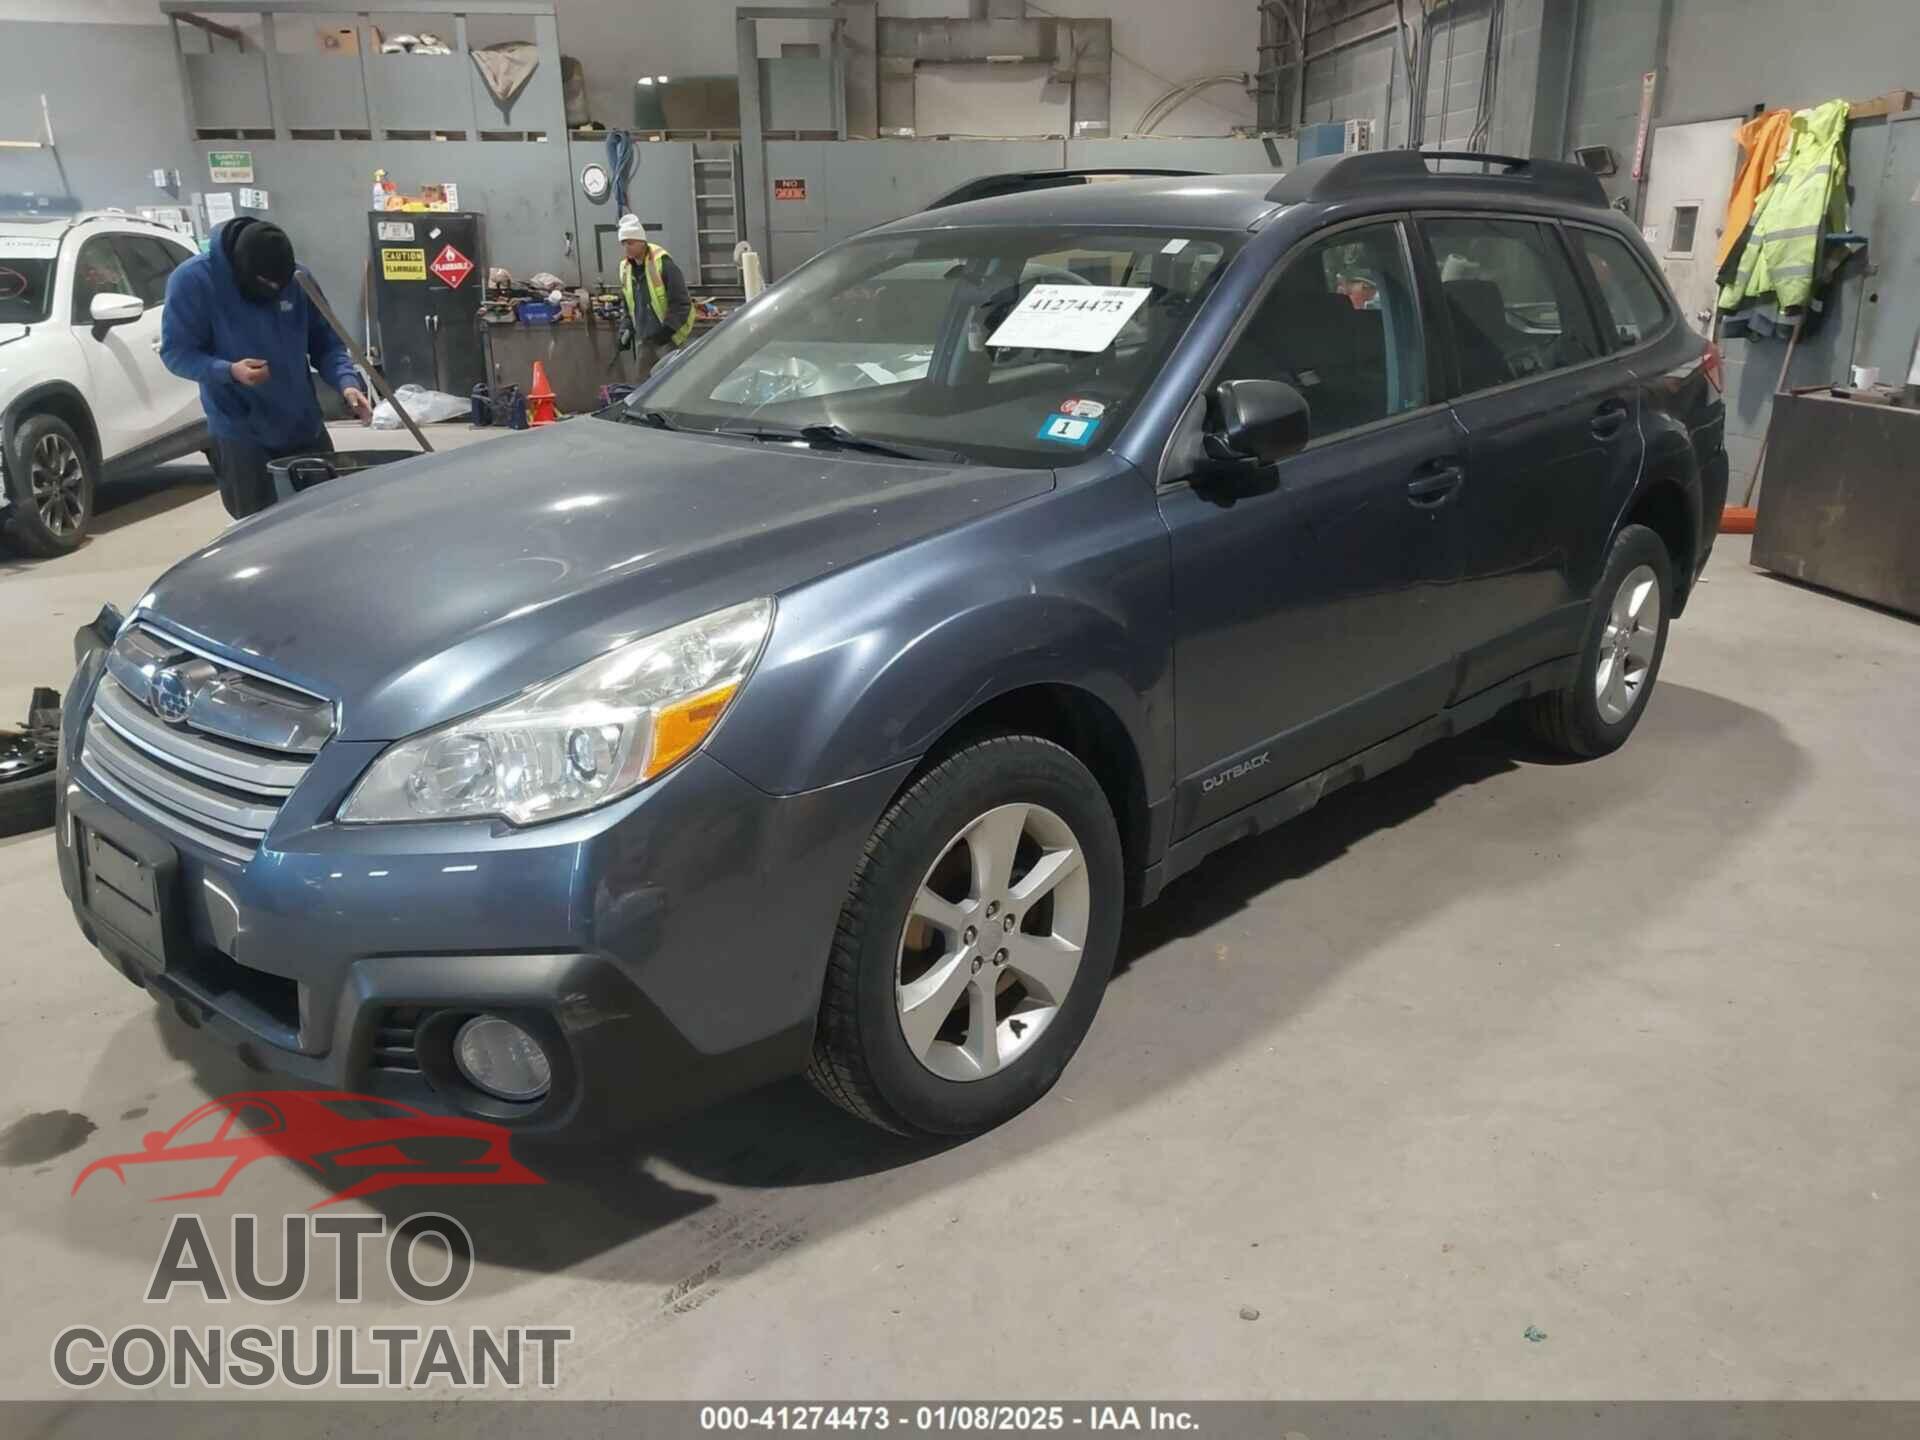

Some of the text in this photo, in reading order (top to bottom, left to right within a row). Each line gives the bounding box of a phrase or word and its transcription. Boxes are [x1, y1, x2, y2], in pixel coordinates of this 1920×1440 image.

[782, 180, 798, 188] NO
[385, 251, 422, 261] CAUTION
[385, 265, 423, 273] FLAMMABLE
[1029, 299, 1124, 313] 41274473
[1057, 421, 1071, 434] 1
[1202, 751, 1271, 792] OUTBACK
